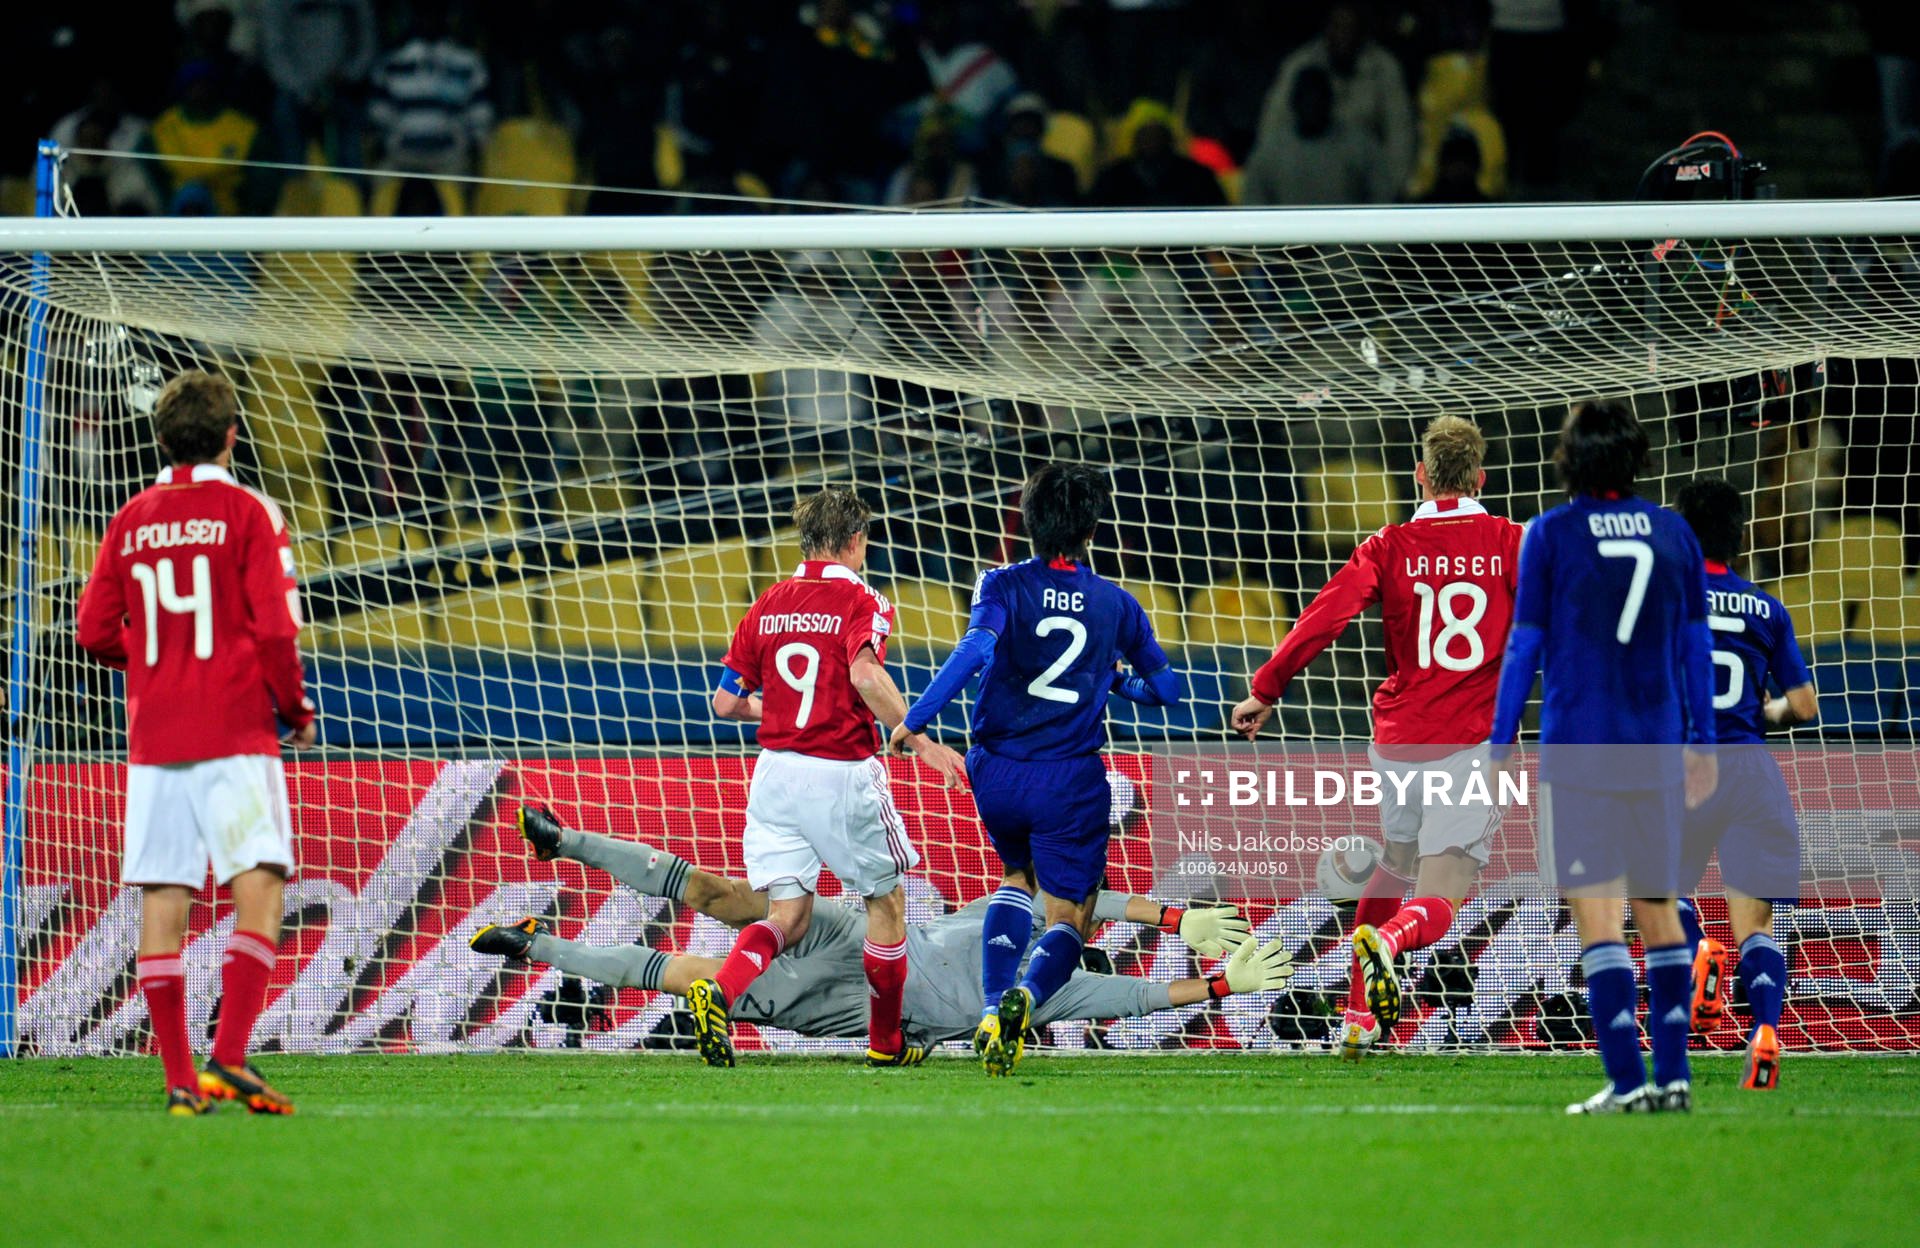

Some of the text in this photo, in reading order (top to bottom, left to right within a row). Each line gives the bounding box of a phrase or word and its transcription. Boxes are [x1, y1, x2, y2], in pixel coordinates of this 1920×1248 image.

[120, 518, 227, 557] J.POULSEN
[1588, 512, 1652, 537] ENDO
[1406, 555, 1502, 577] LARSEN
[1597, 540, 1654, 645] 7
[131, 554, 213, 667] 14
[759, 612, 842, 636] TOMASSON
[1043, 588, 1084, 612] ABE
[1413, 582, 1487, 671] 18
[1706, 590, 1770, 619] ATOMO
[775, 642, 820, 729] 9
[1027, 616, 1087, 704] 2
[1707, 615, 1746, 709] 5
